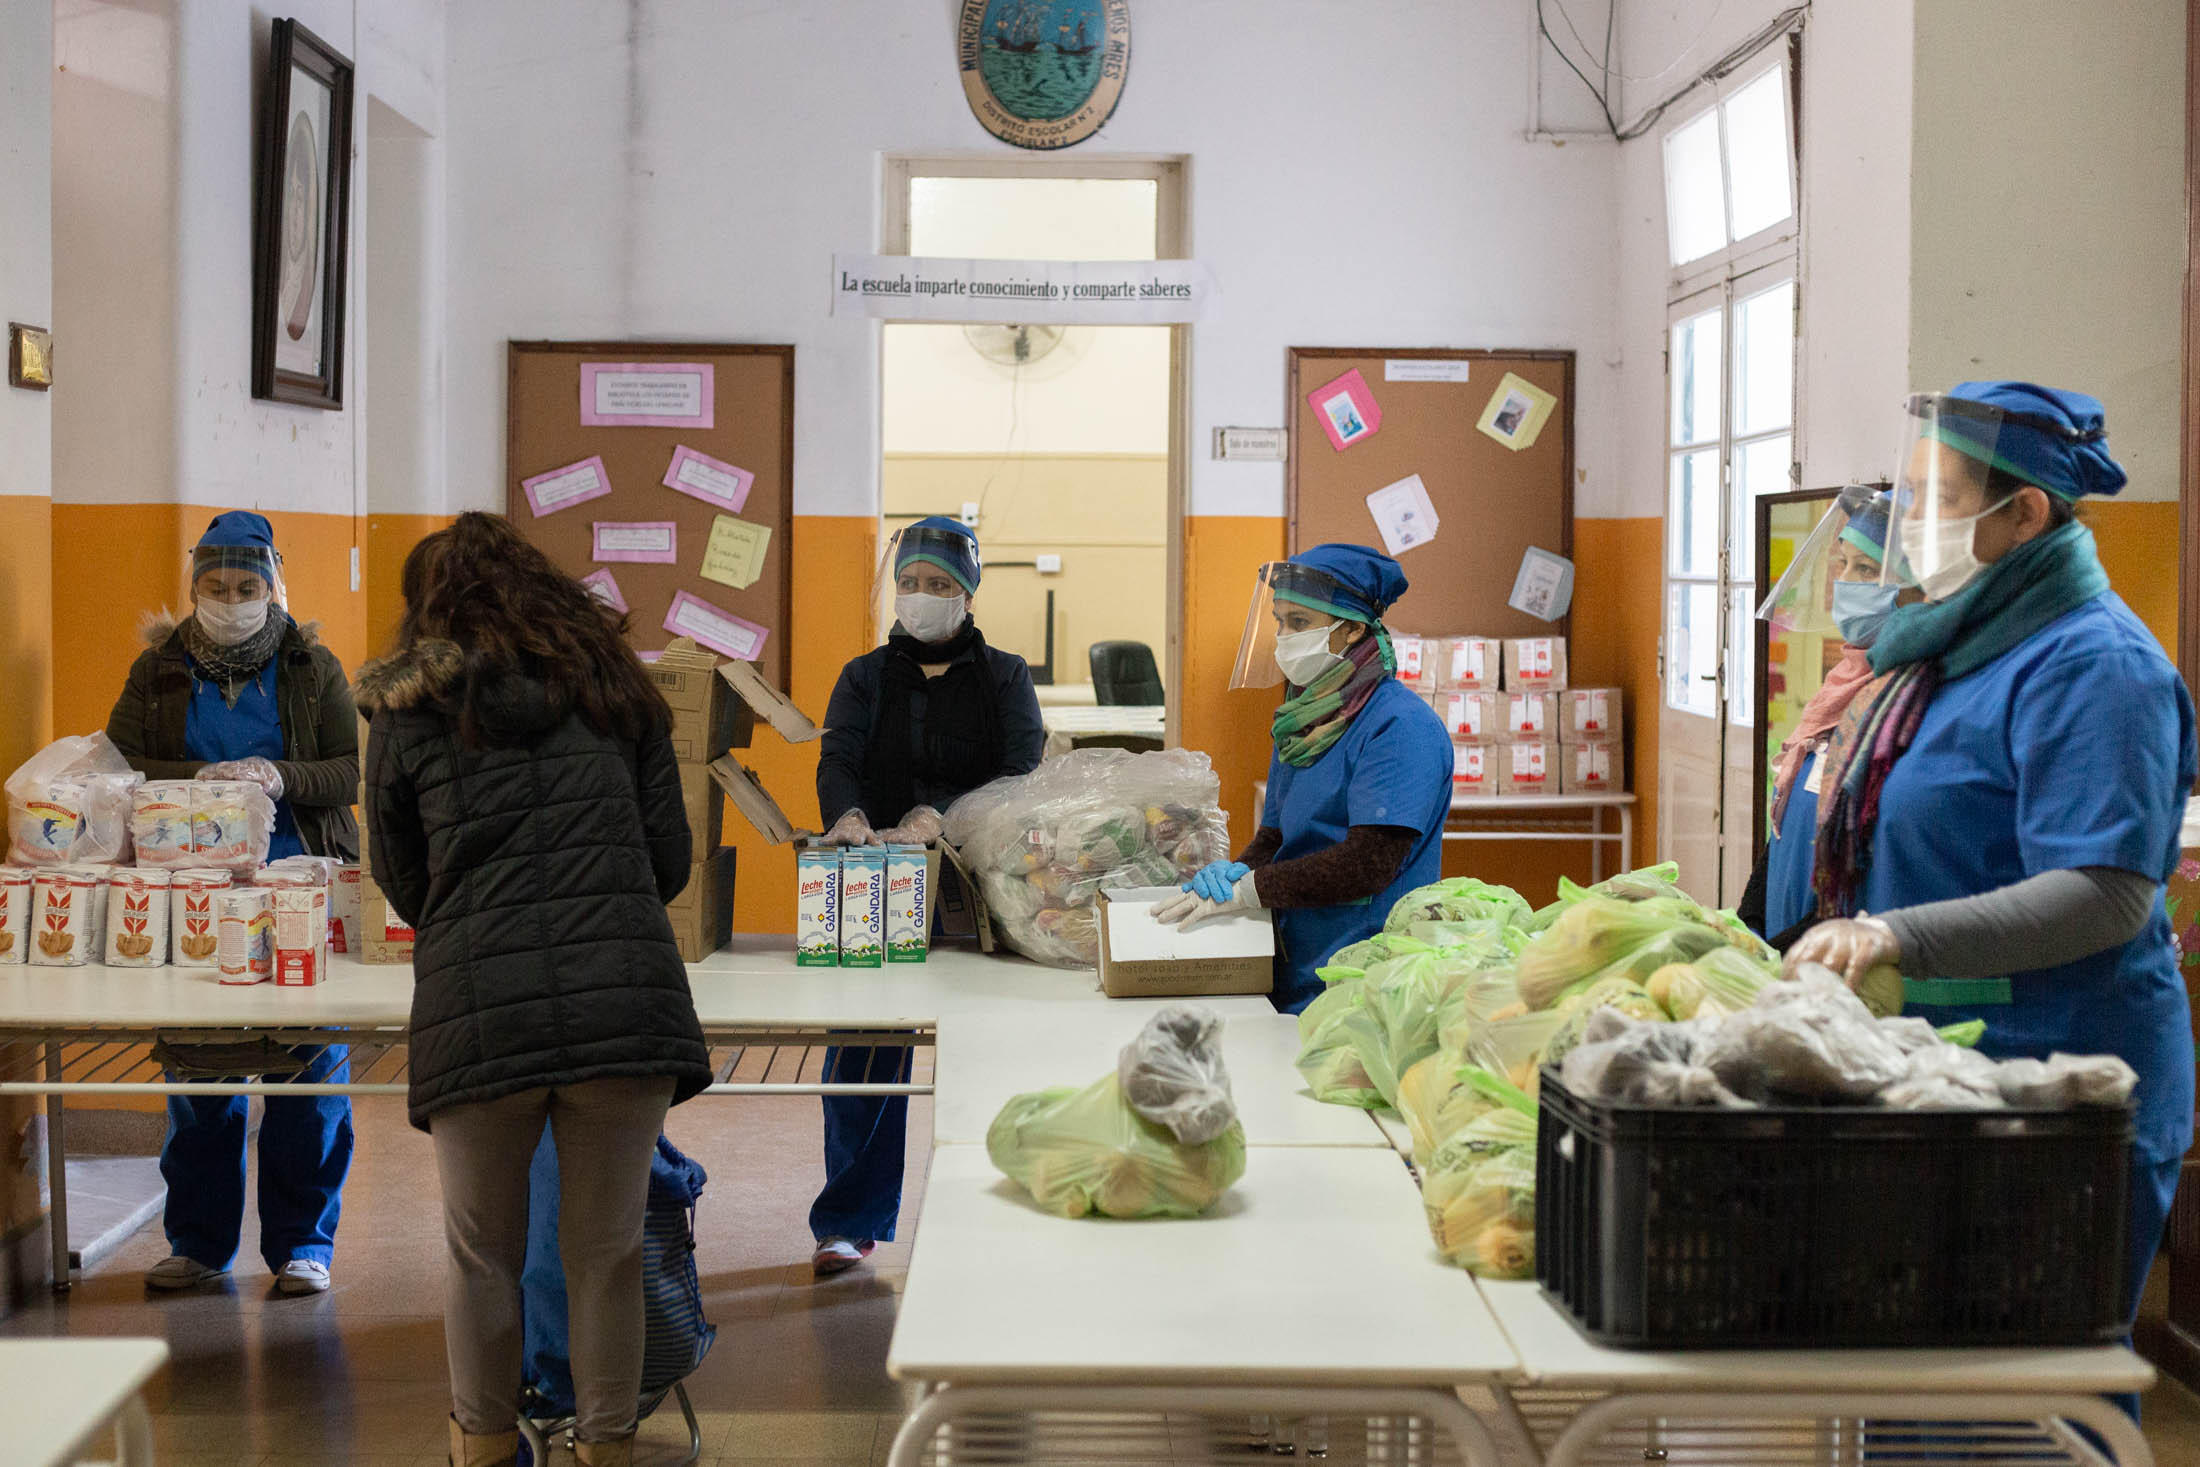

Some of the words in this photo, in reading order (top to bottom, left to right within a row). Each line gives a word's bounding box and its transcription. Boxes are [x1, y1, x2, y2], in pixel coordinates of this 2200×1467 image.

[1103, 40, 1126, 80] AIRES
[983, 101, 1025, 133] DISTRITO
[1028, 118, 1077, 137] ESCOLAR
[841, 271, 858, 292] La
[862, 274, 912, 295] escuela
[915, 275, 965, 298] imparte
[969, 277, 1058, 298] conocimiento
[1062, 283, 1070, 301] y
[1073, 279, 1136, 300] comparte
[1139, 277, 1192, 298] saberes
[801, 879, 824, 896] Leche
[845, 881, 868, 897] Leche
[890, 876, 912, 892] Leche
